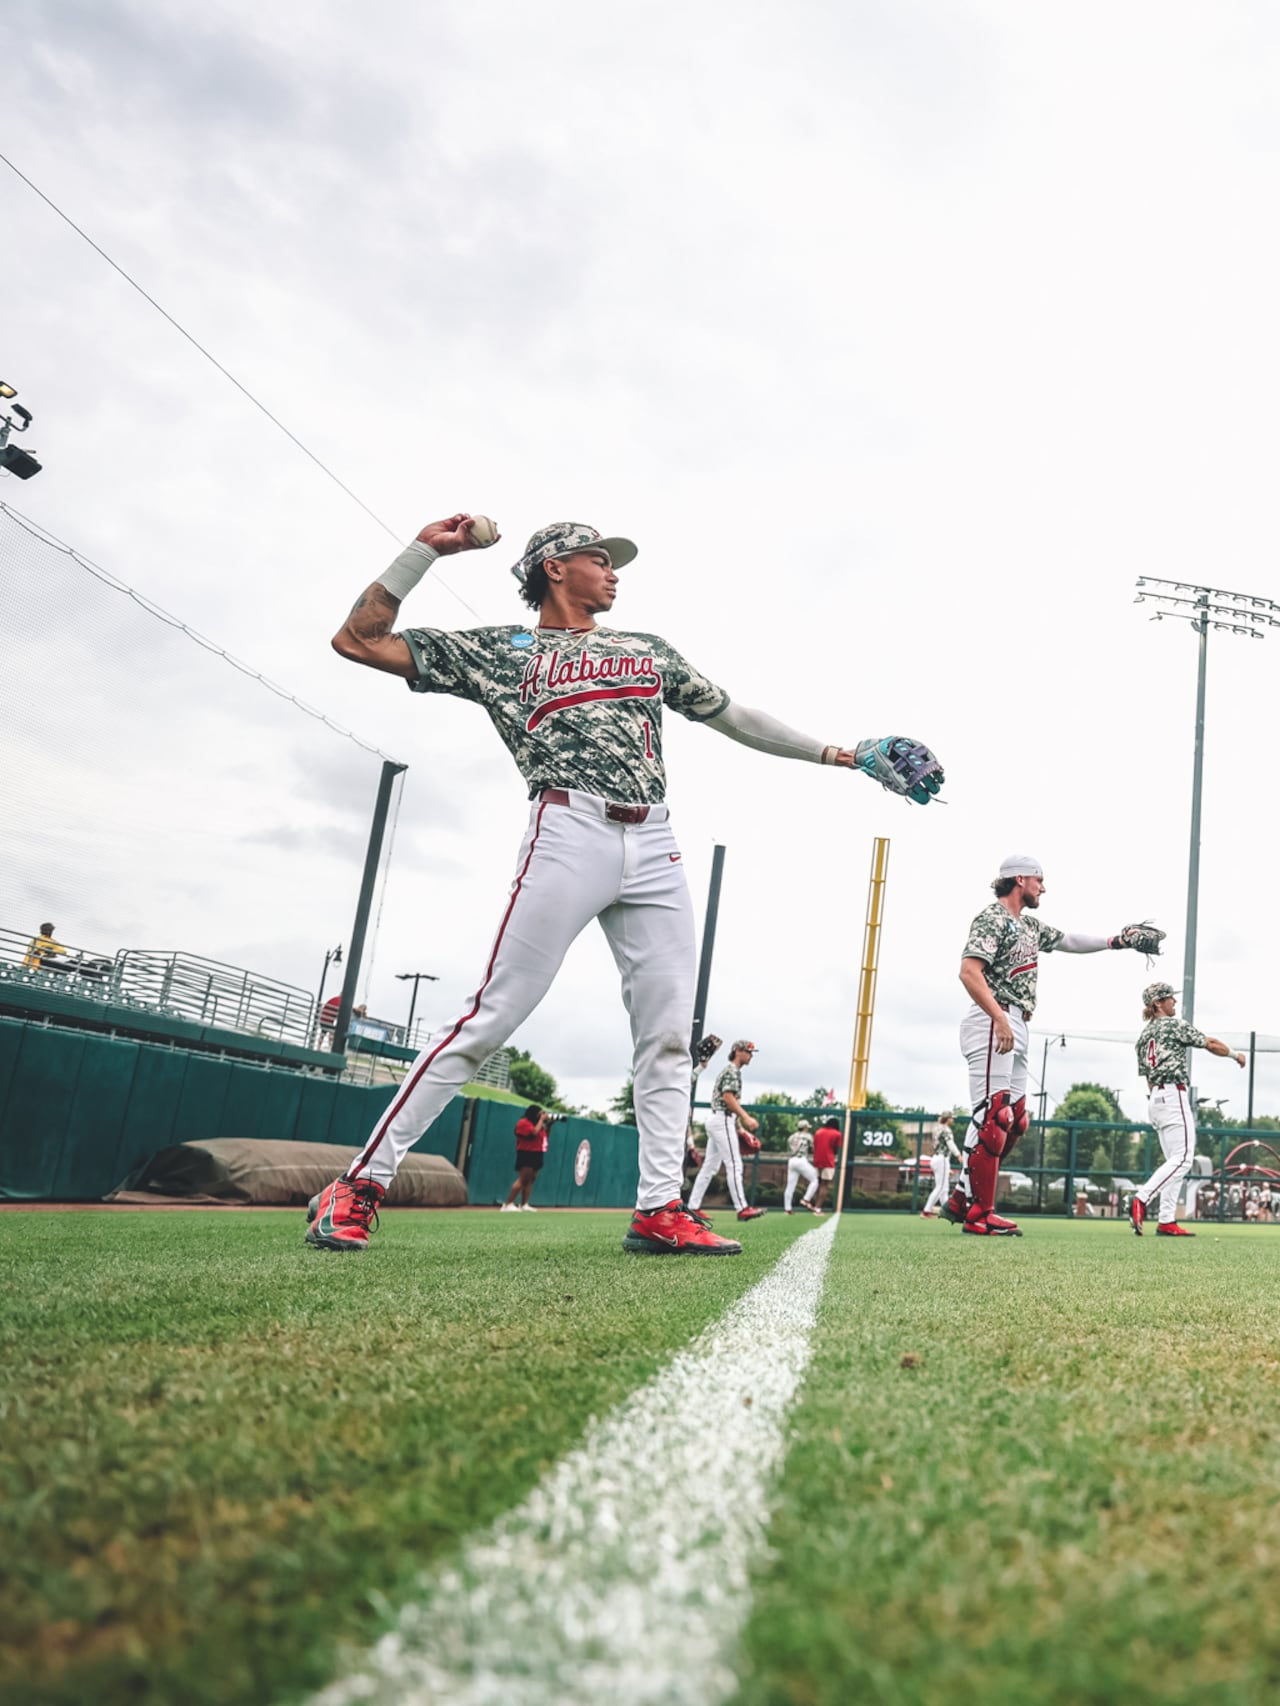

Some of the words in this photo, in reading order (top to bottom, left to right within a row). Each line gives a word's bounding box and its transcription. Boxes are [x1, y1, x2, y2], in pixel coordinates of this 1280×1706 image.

[518, 650, 656, 704] Alabama
[642, 720, 654, 760] 1
[1146, 1038, 1159, 1068] 4
[862, 1131, 893, 1146] 320
